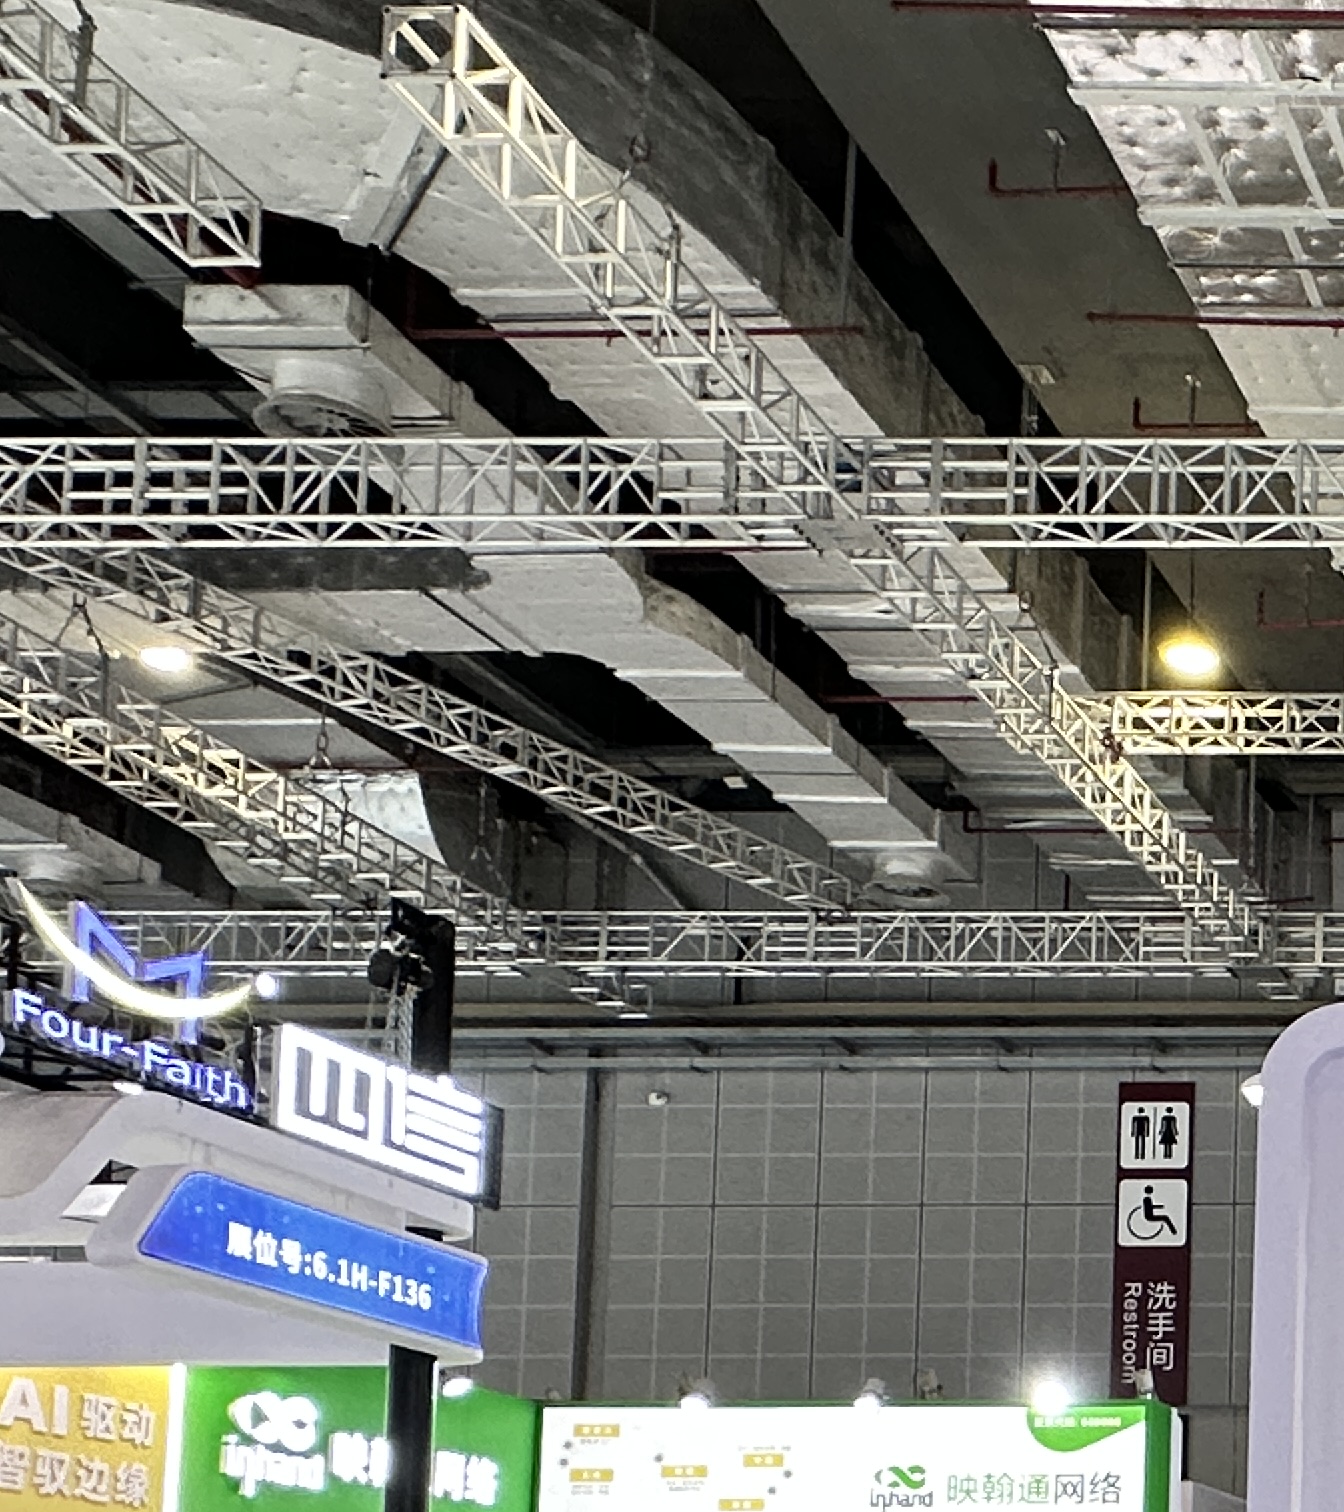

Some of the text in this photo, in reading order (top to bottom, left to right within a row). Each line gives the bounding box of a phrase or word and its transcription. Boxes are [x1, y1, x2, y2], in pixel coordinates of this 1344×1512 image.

[11, 987, 252, 1109] Four-Faith
[226, 1220, 433, 1311] 展位号:6.1H-F136
[1119, 1281, 1143, 1385] Restroom
[1146, 1281, 1177, 1373] 洗手间
[0, 1376, 156, 1448] AI 驱动
[946, 1470, 1122, 1506] 映翰通网络
